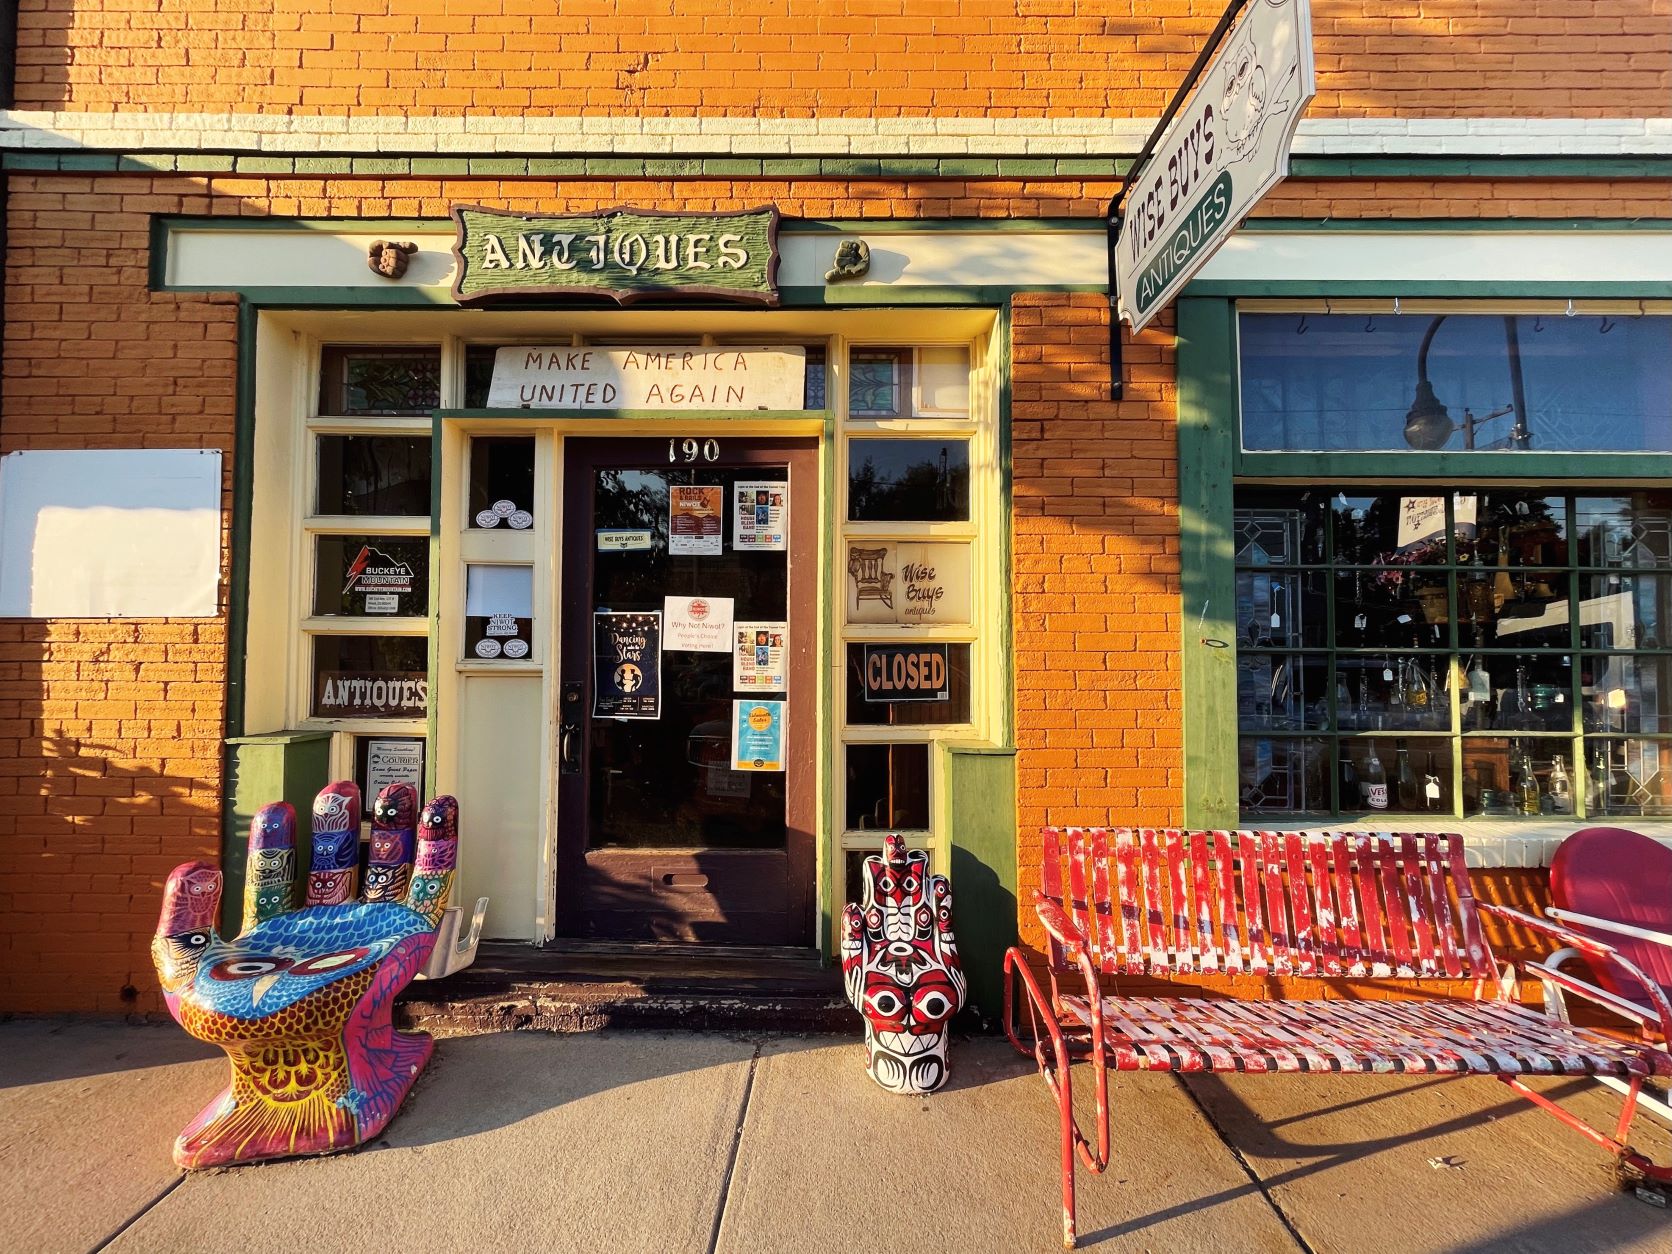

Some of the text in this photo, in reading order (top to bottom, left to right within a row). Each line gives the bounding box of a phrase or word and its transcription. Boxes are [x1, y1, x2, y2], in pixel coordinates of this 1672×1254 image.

[1129, 103, 1215, 262] WISE BUYS
[481, 232, 749, 275] ANTIQUES
[1140, 182, 1226, 307] ANTIQUES
[524, 350, 748, 371] MAKE AMERICA
[519, 383, 745, 404] UNITED AGAIN
[668, 438, 720, 463] 190
[679, 487, 704, 495] ROCK
[362, 576, 410, 584] MOUNTAIN
[902, 563, 937, 583] Wise
[906, 583, 944, 607] Buys
[611, 632, 647, 648] Dancing
[616, 644, 642, 663] Stars
[868, 654, 945, 690] CLOSED
[322, 677, 428, 711] ANTIQUES
